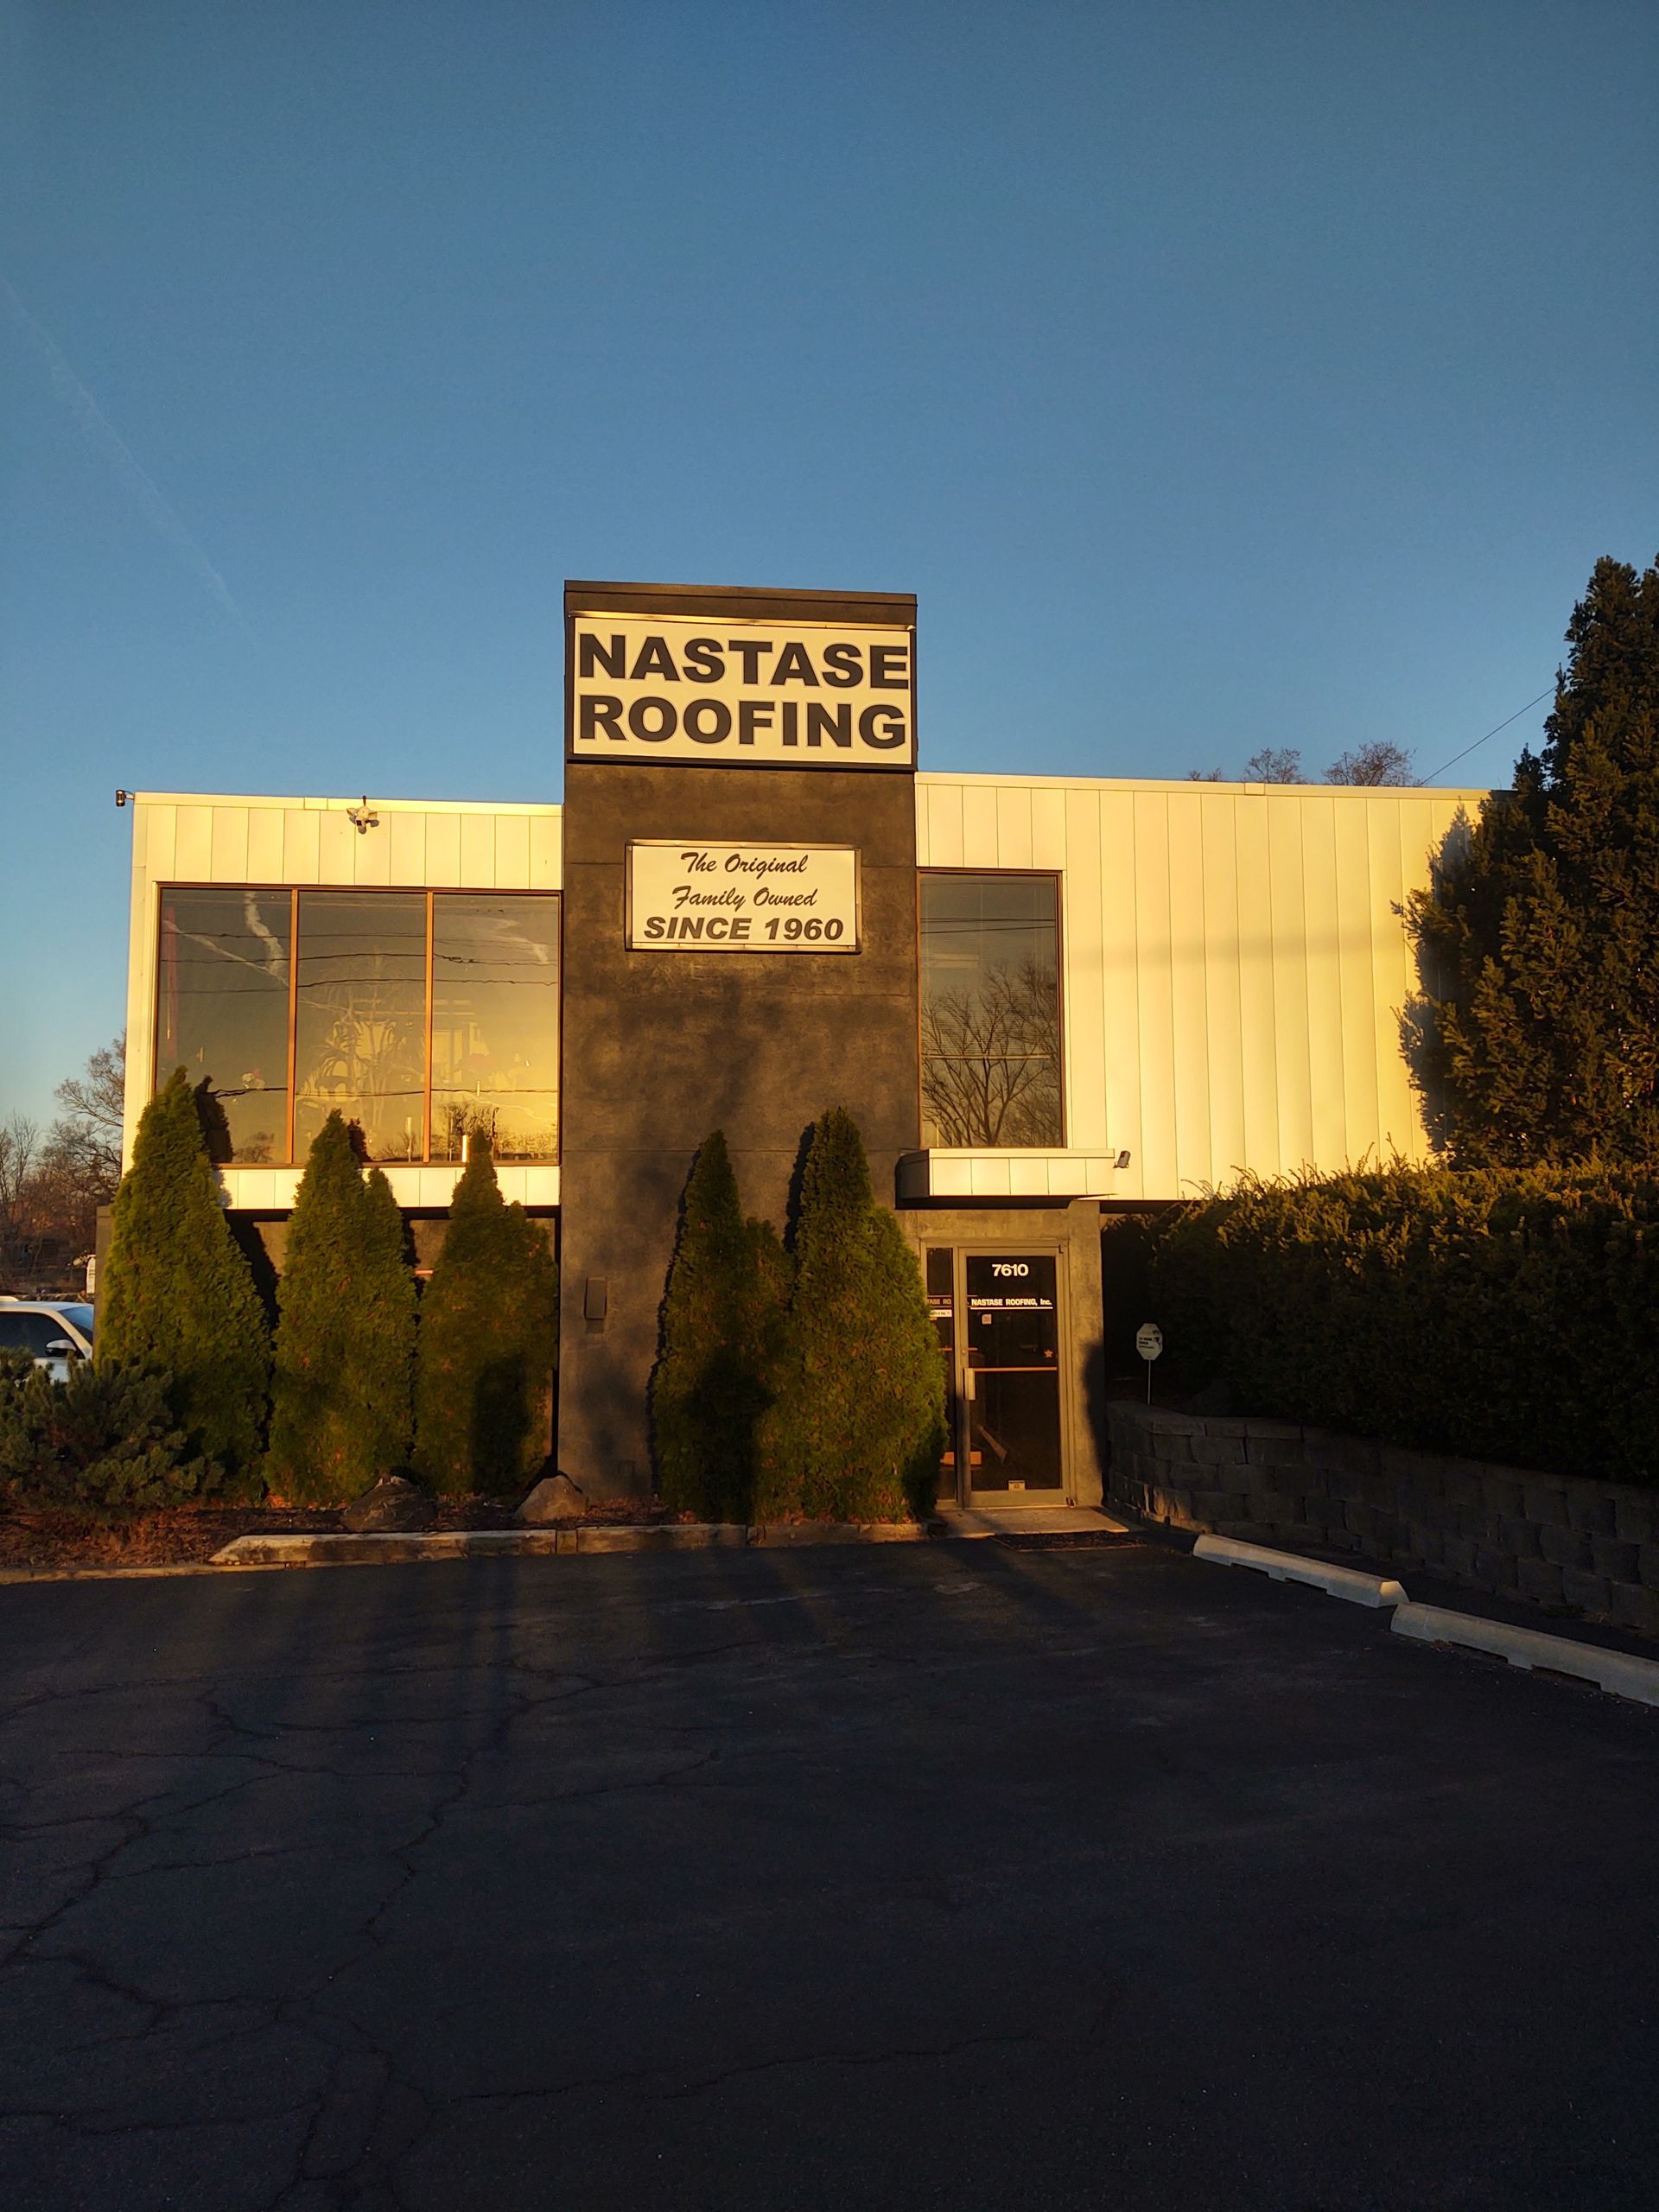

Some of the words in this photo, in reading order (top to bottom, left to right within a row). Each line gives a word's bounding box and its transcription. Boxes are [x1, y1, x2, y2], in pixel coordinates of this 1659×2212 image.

[579, 633, 909, 690] NASTASE
[579, 695, 906, 749] ROOFING
[680, 852, 717, 874] The
[724, 854, 809, 879] Original
[671, 885, 746, 912] Family
[753, 887, 817, 907] Owned
[644, 917, 752, 940] SINCE
[764, 917, 843, 941] 1960
[991, 1263, 1029, 1277] 7610
[971, 1298, 1003, 1306] NASTASE
[1005, 1298, 1038, 1306] ROOFING,
